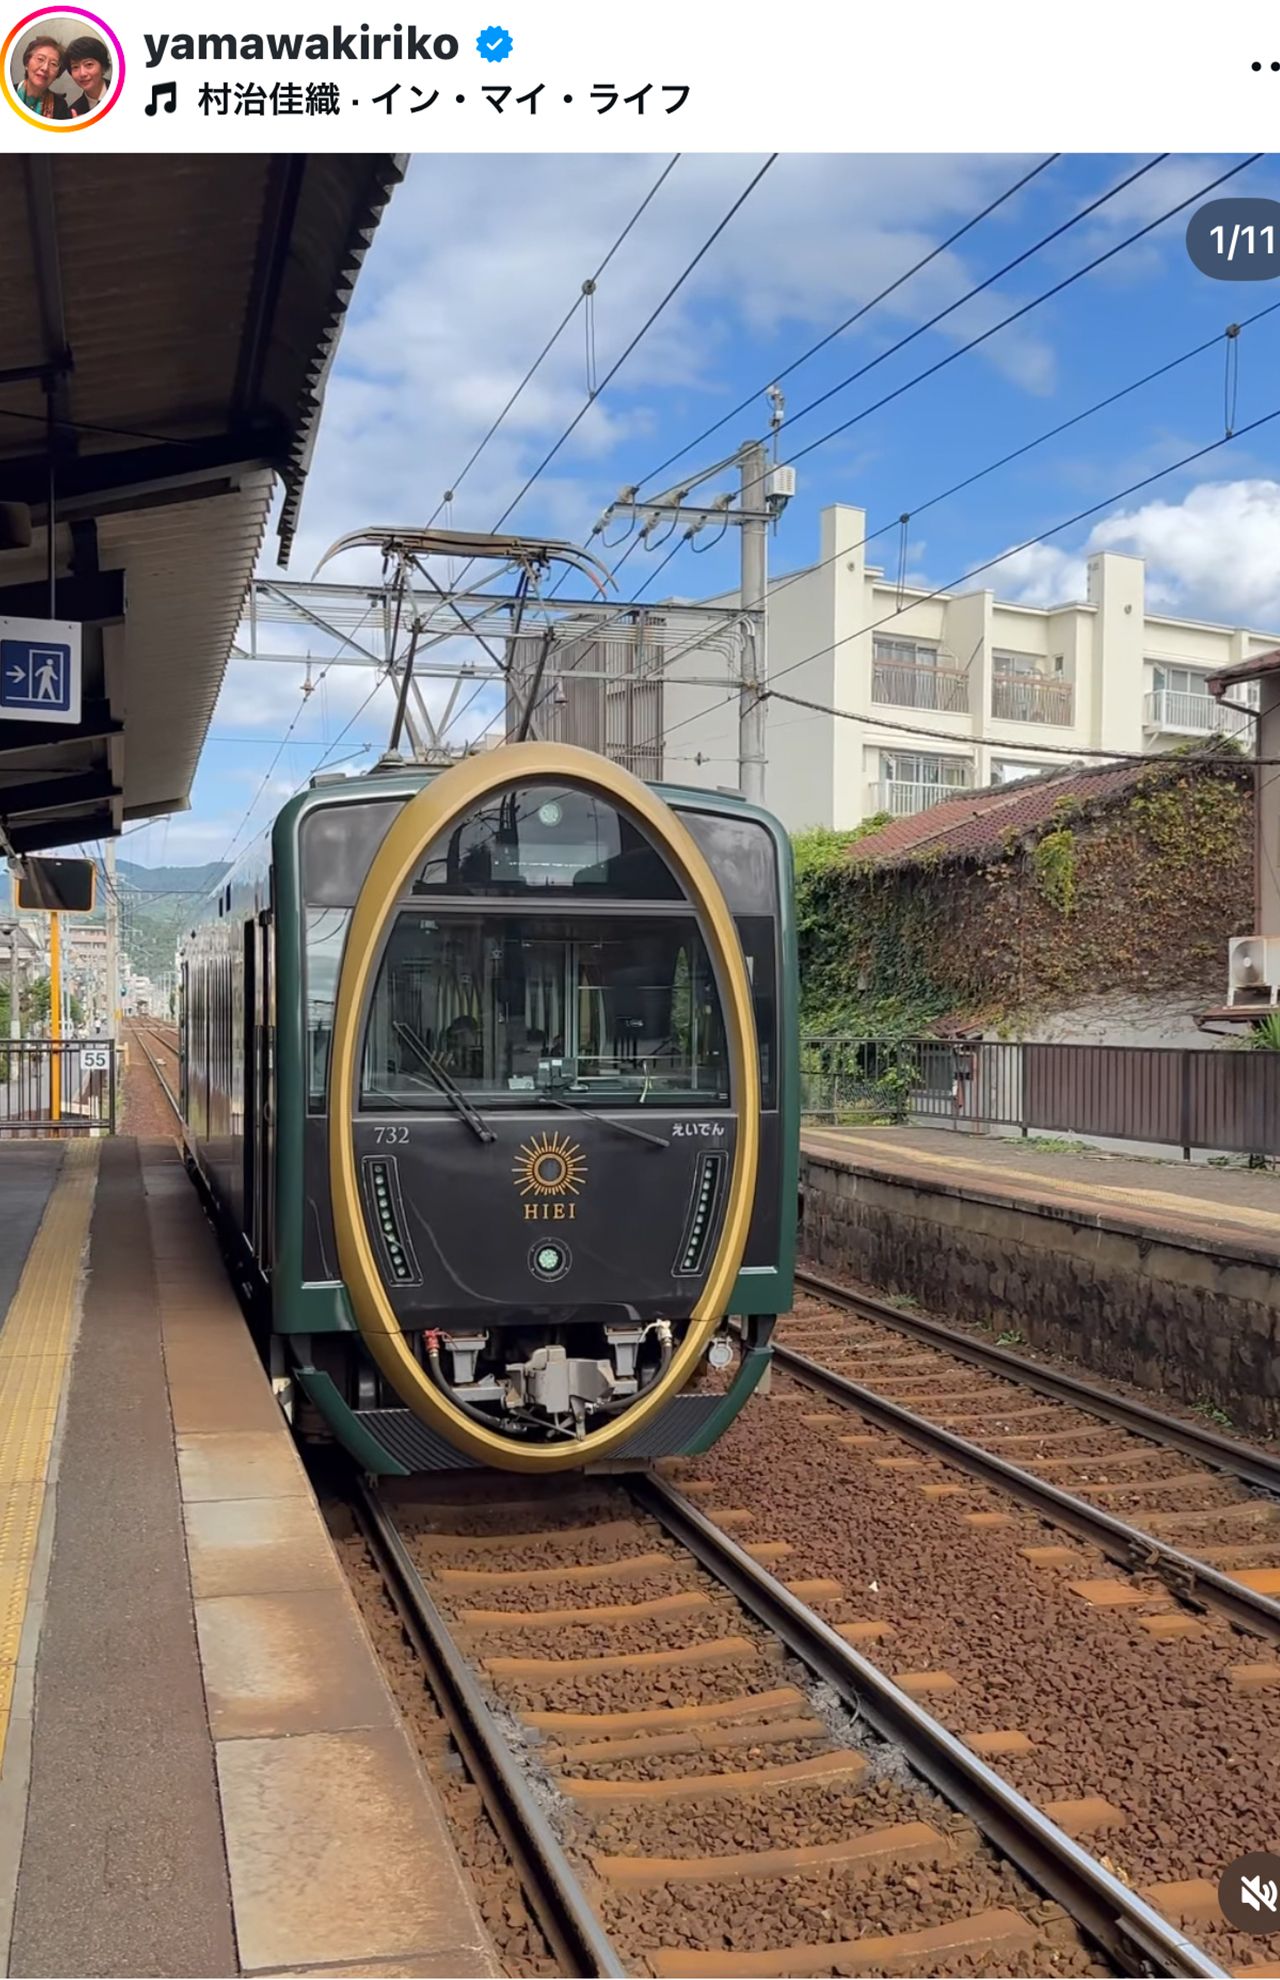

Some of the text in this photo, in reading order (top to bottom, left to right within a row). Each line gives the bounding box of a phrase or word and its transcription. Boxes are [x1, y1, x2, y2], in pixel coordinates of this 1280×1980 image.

[84, 1053, 106, 1067] 55
[373, 1126, 410, 1144] 732
[672, 1121, 726, 1138] えいでん
[523, 1202, 577, 1220] HIEI
